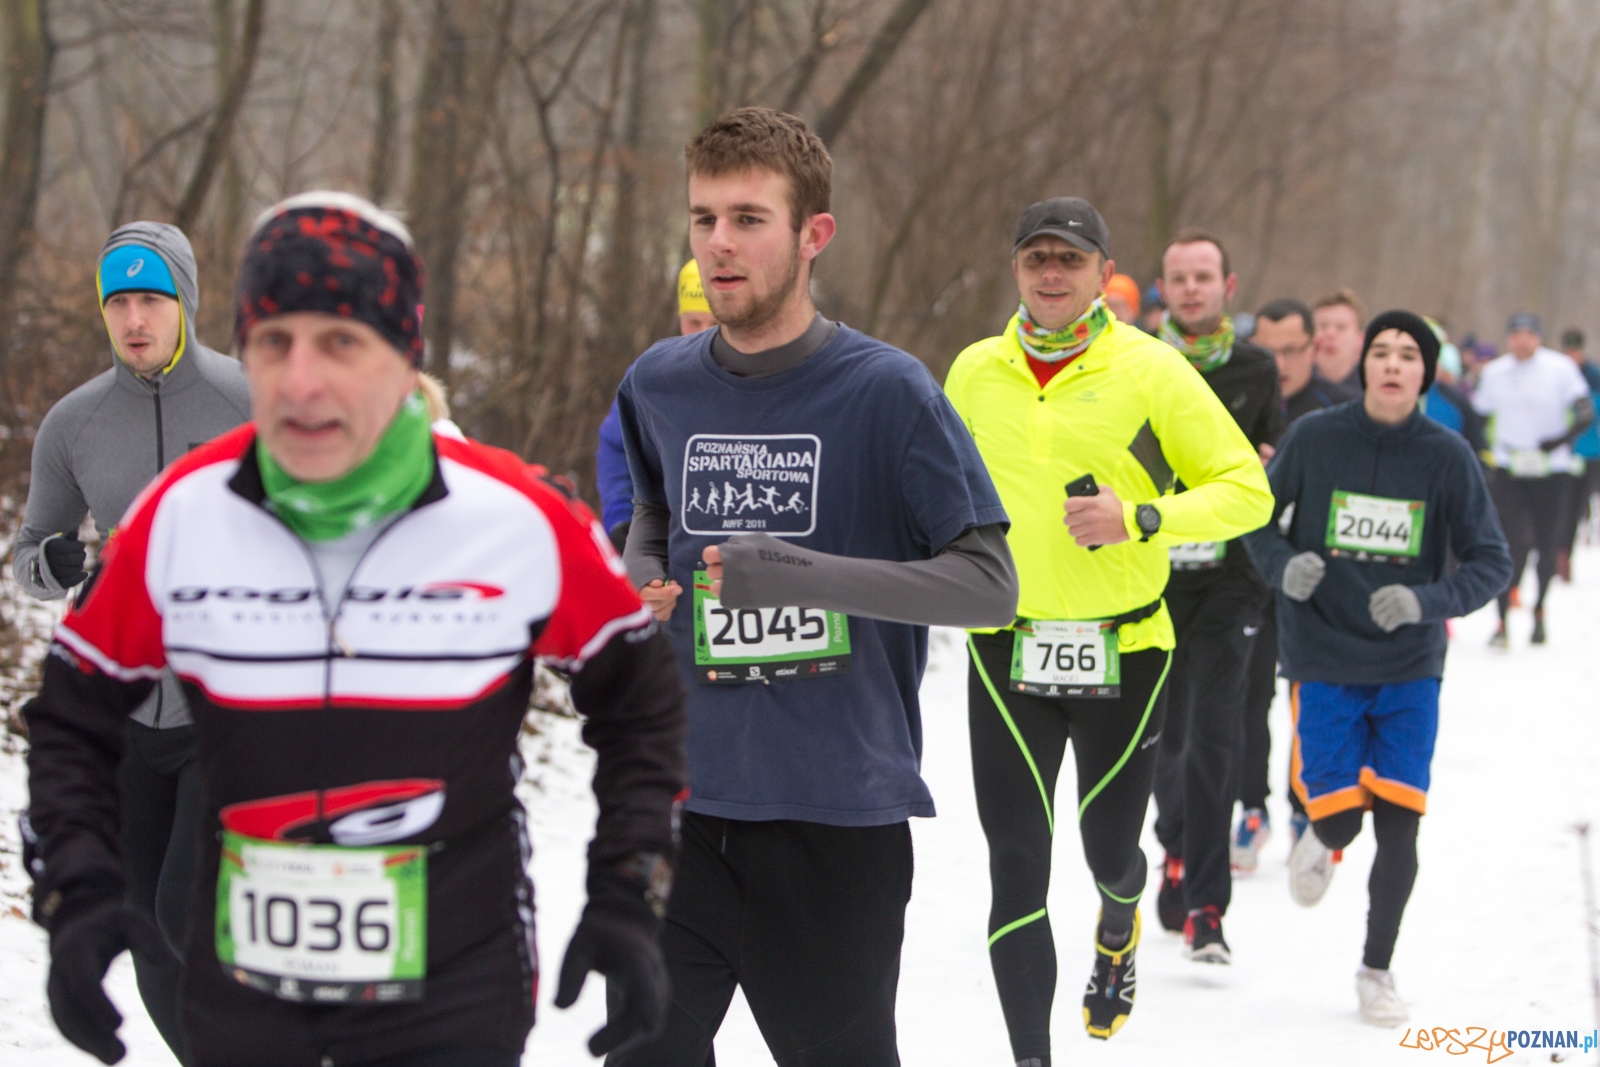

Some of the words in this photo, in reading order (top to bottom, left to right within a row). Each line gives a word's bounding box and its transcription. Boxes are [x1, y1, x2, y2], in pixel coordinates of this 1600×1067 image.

[688, 451, 814, 472] SPARTAKIADA
[696, 441, 768, 455] POZNAŃSKA
[736, 468, 810, 484] SPORTOWA
[722, 519, 743, 528] AWF
[745, 519, 766, 528] 2011
[1340, 515, 1409, 542] 2044
[710, 607, 825, 646] 2045
[833, 612, 843, 643] Pozna
[1036, 643, 1096, 672] 766
[243, 891, 390, 952] 1036
